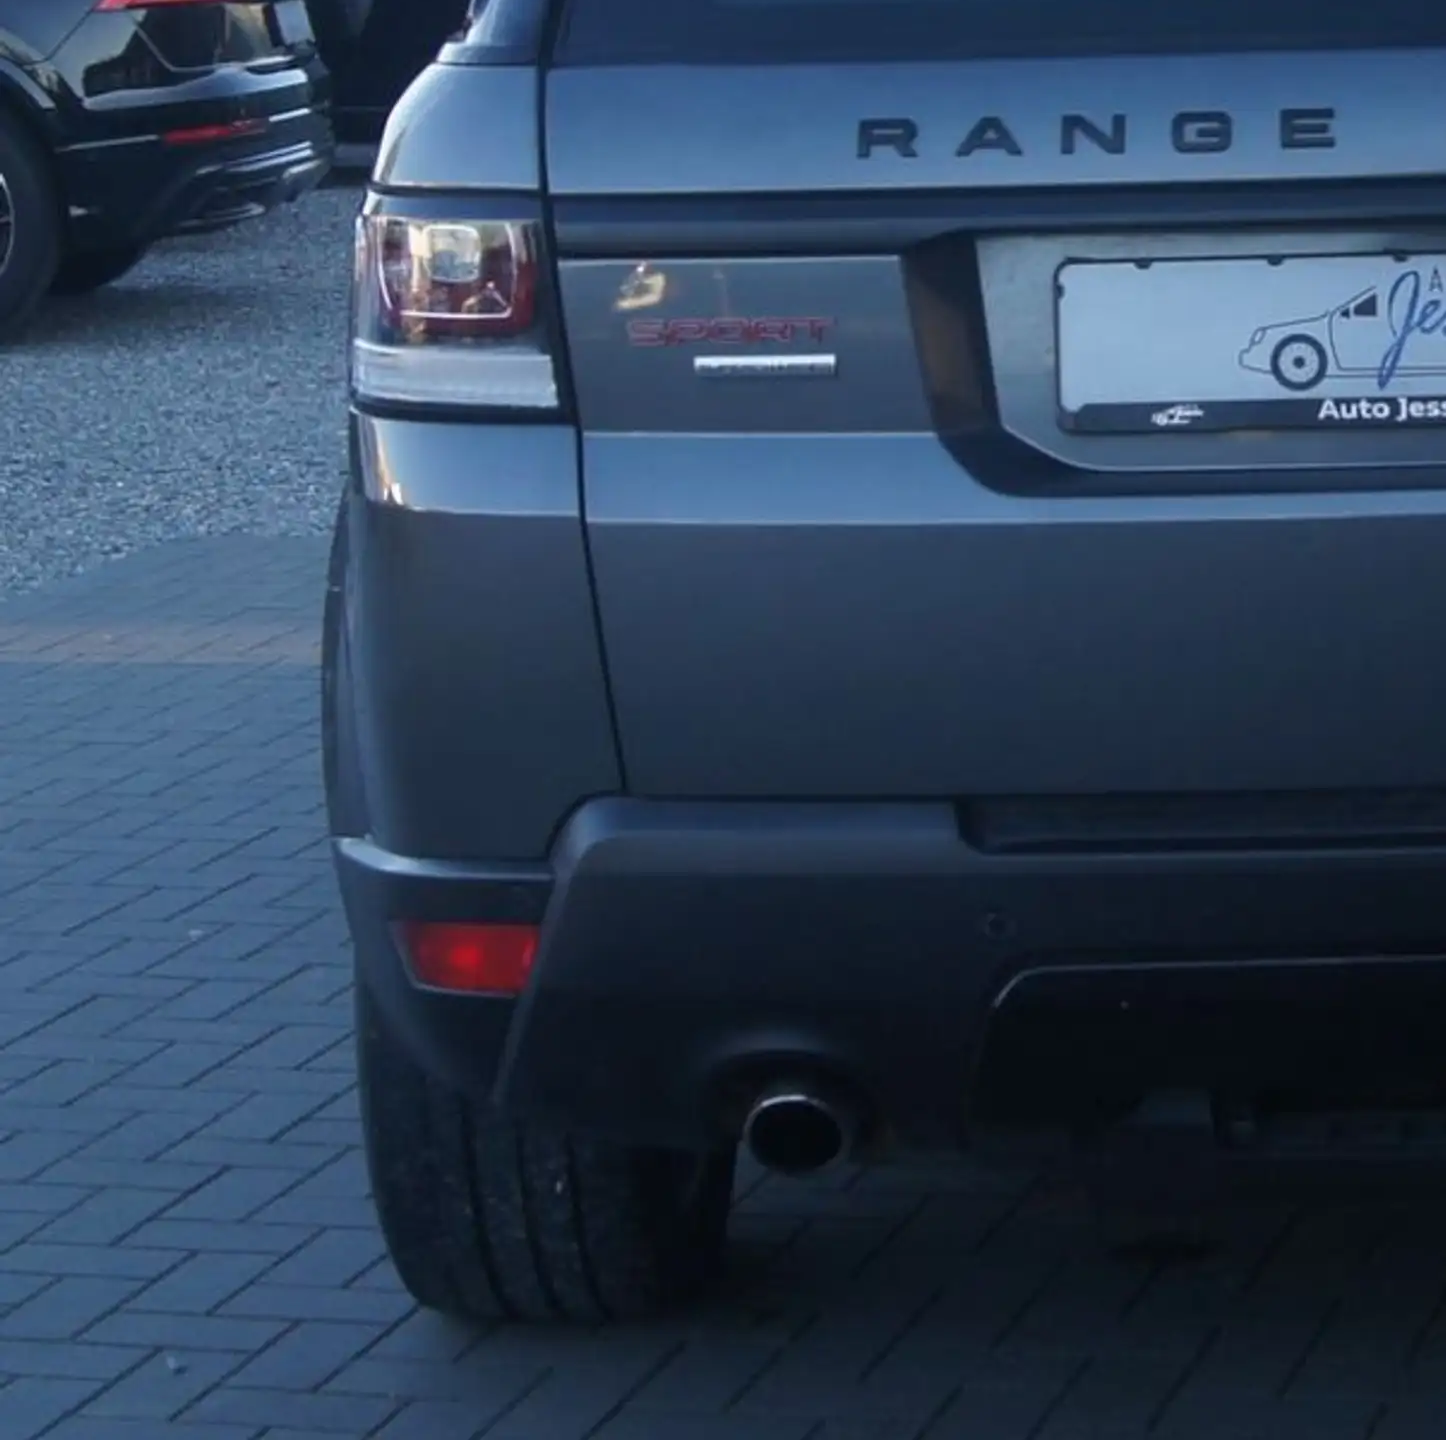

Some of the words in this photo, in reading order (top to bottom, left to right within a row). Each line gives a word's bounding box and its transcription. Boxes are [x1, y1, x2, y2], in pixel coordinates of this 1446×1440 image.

[855, 107, 1338, 158] RANGE
[627, 316, 834, 347] SPORT
[1318, 399, 1391, 420] Auto
